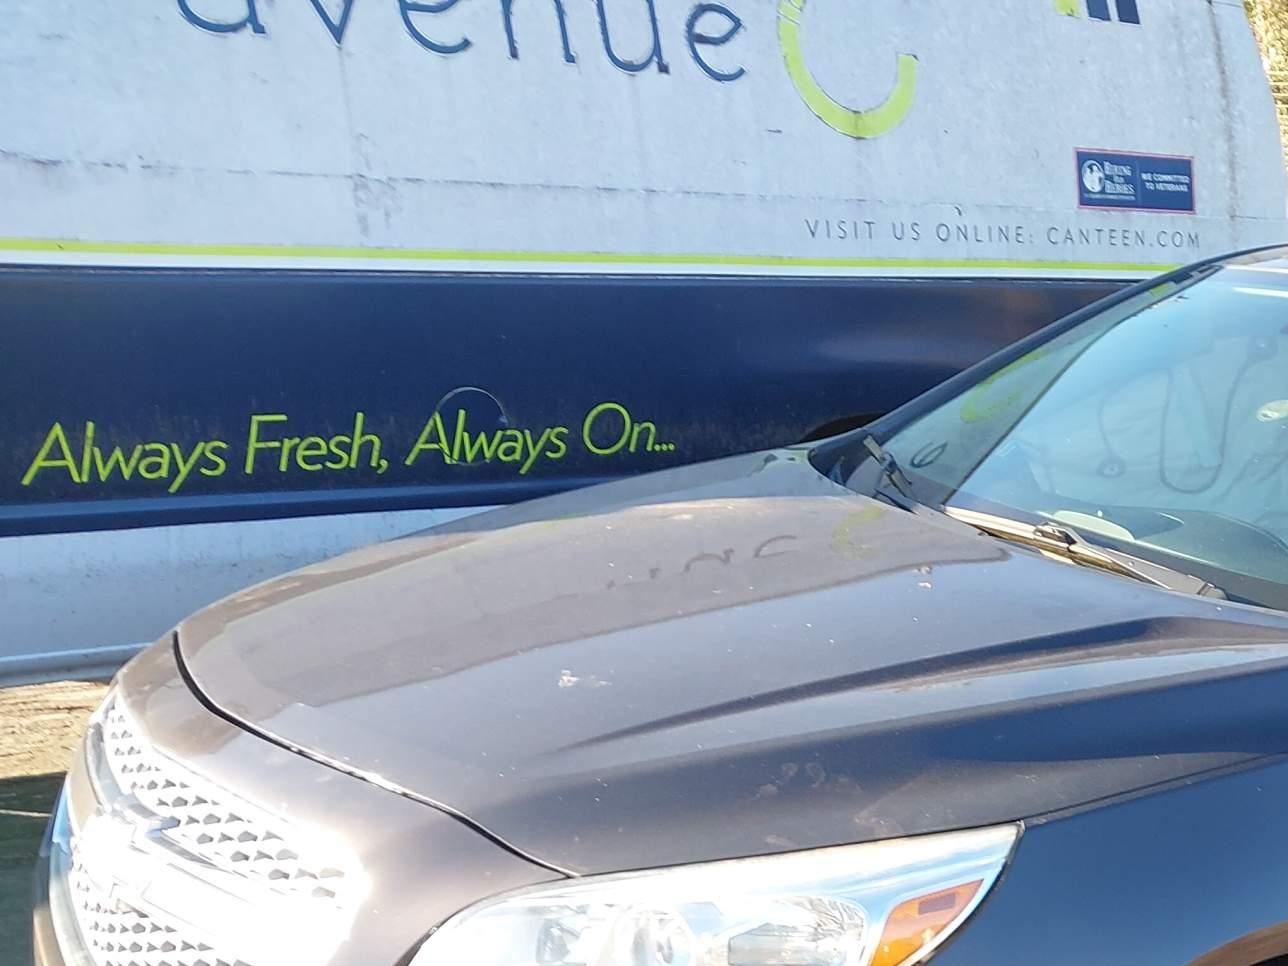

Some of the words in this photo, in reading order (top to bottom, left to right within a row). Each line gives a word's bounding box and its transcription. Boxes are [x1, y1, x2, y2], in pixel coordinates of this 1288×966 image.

[804, 218, 876, 240] VISIT
[891, 221, 922, 242] US
[935, 222, 1035, 245] ONLINE:
[1046, 226, 1200, 249] CANTEEN.COM
[21, 420, 227, 494] Always
[244, 411, 389, 475] Fresh,
[404, 407, 569, 475] Always
[581, 401, 676, 456] On...
